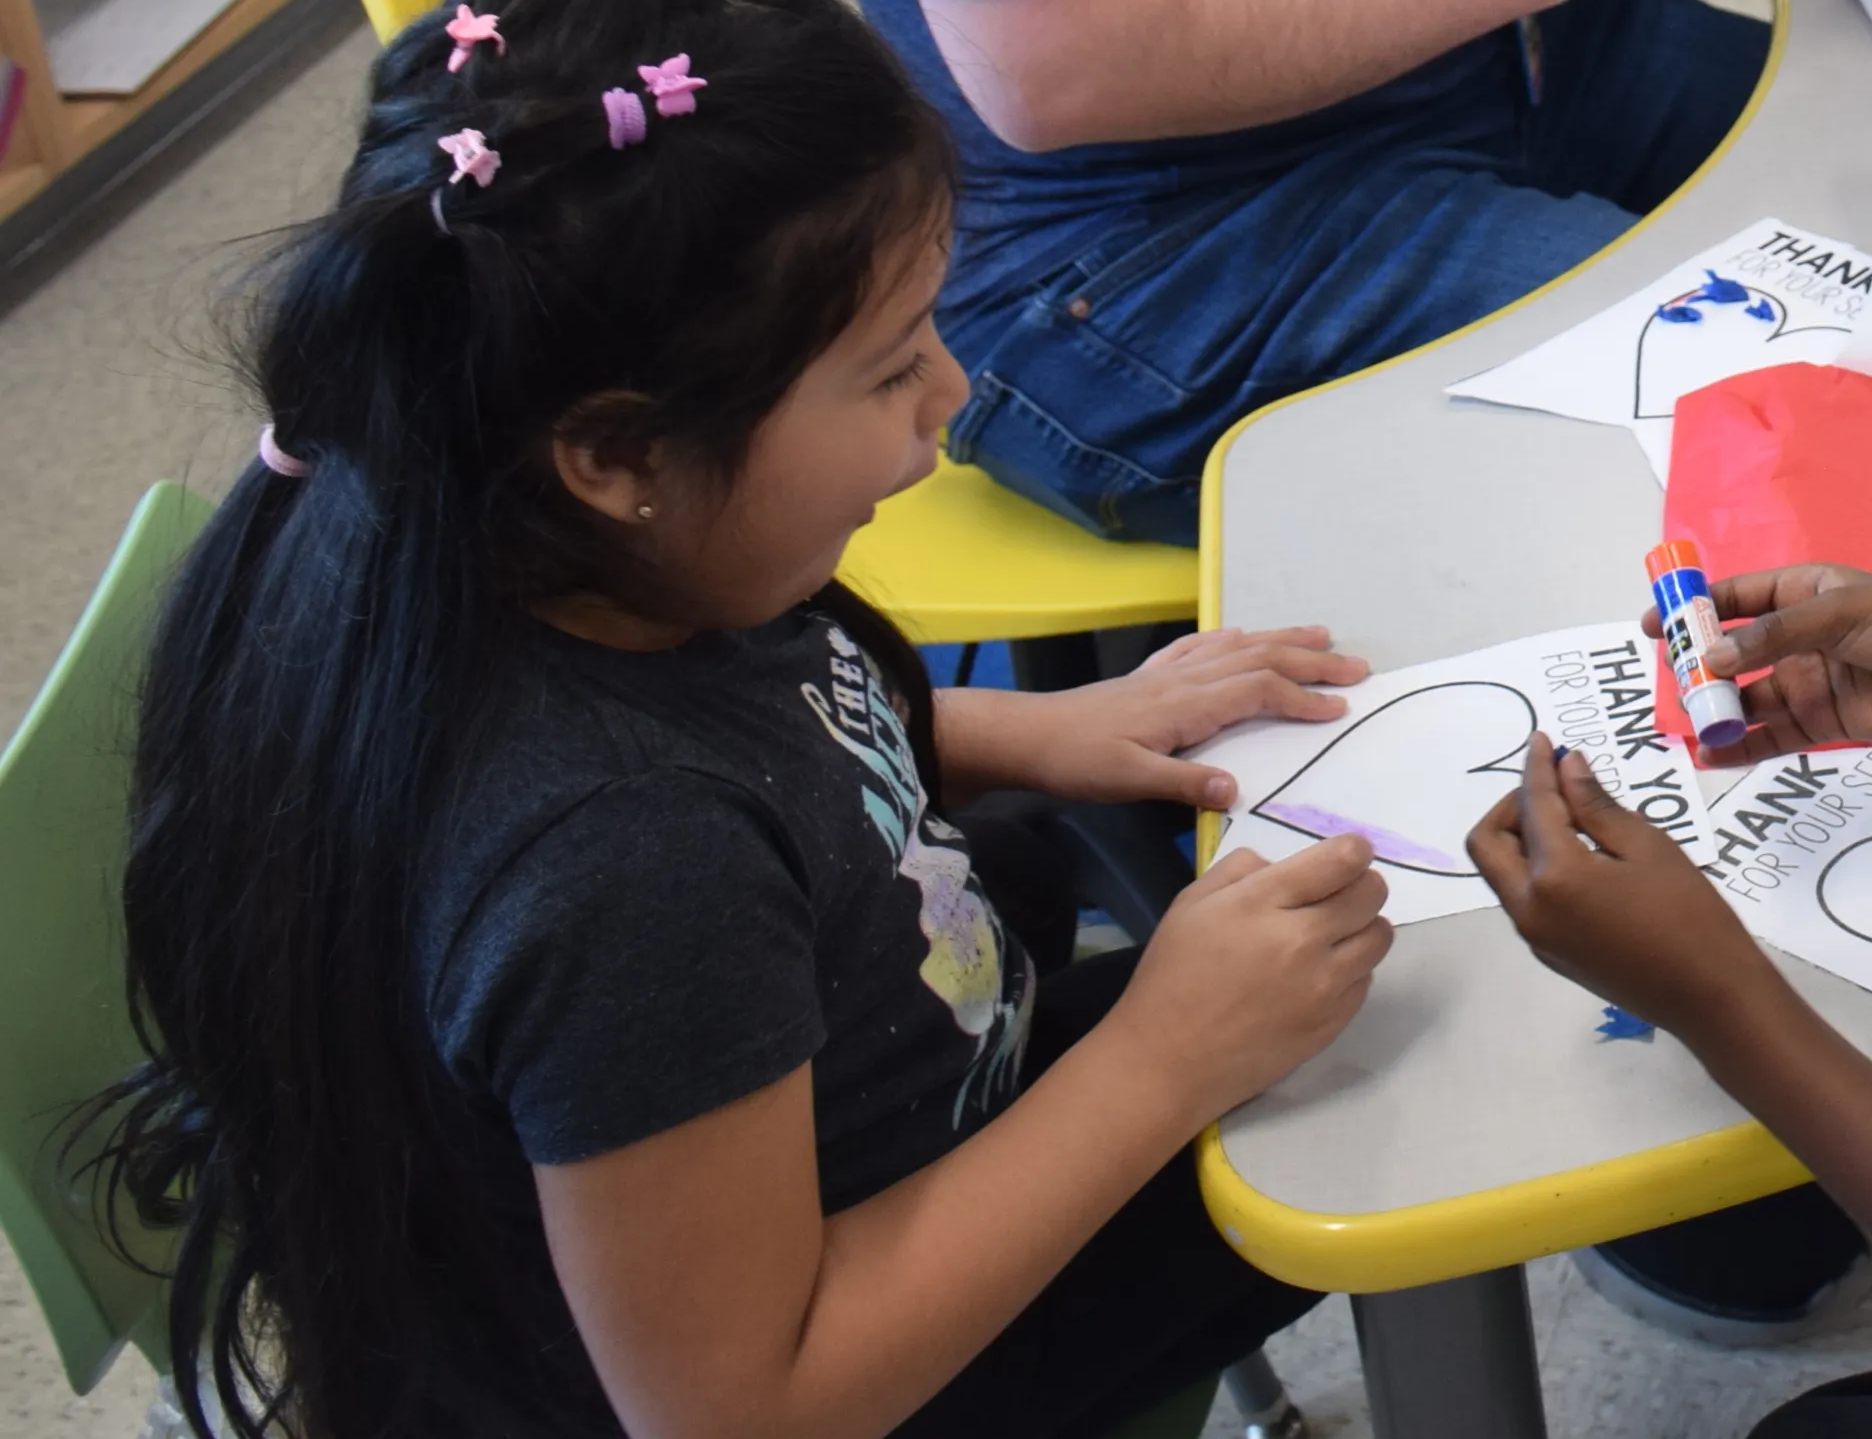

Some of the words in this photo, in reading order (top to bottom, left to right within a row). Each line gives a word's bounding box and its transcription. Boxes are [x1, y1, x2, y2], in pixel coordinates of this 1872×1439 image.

[829, 656, 870, 735] THE
[1541, 650, 1590, 693] FOR
[1589, 639, 1670, 761] THANK
[1553, 694, 1608, 750] YOUR
[1726, 852, 1799, 903] FOR
[1776, 793, 1863, 854] YOUR
